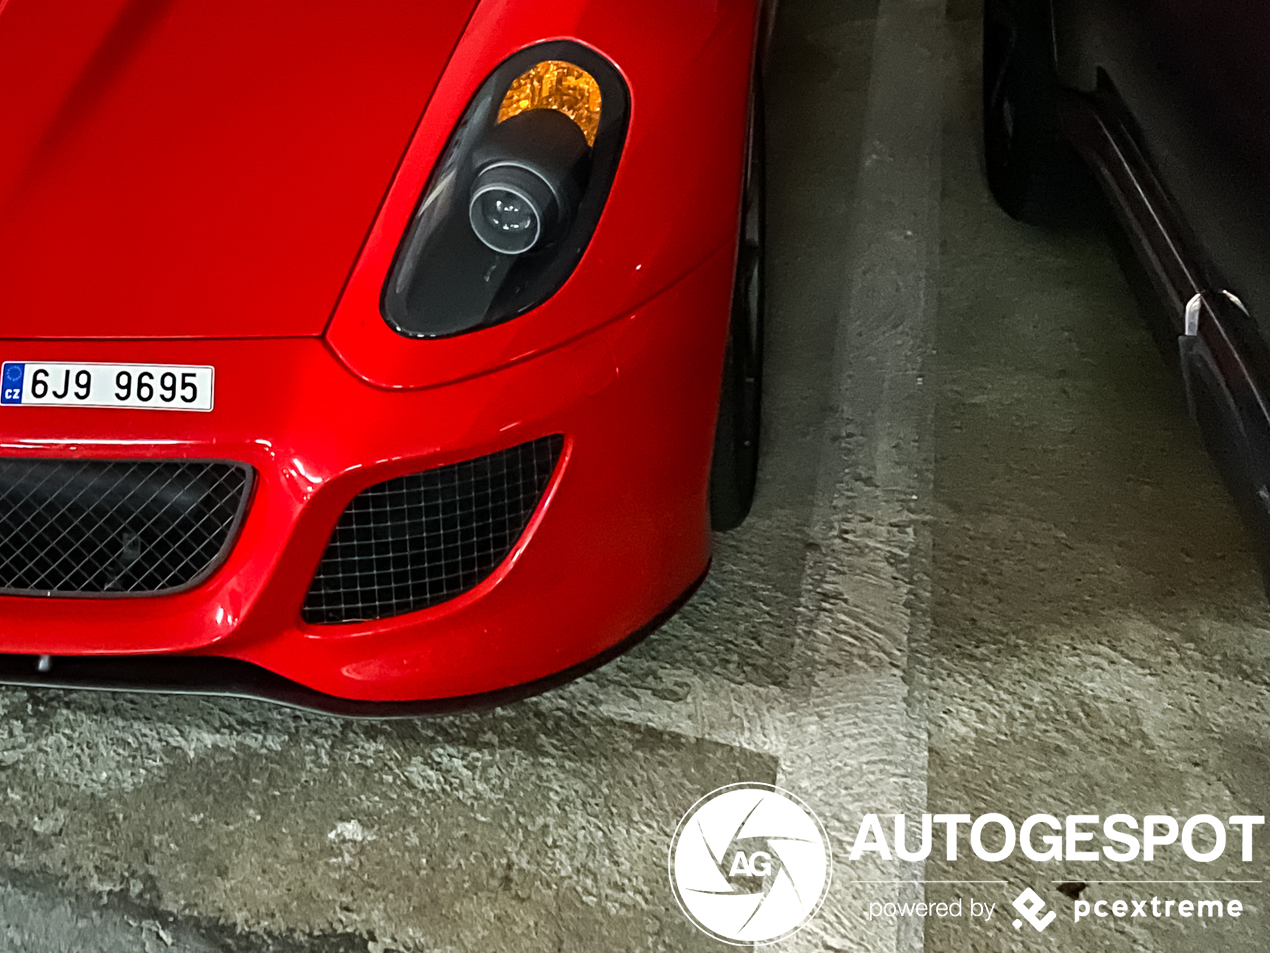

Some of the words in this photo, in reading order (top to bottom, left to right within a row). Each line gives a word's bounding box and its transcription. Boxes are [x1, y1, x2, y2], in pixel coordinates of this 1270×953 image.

[5, 389, 20, 399] CZ
[31, 369, 92, 400] 6J9
[114, 371, 198, 403] 9695
